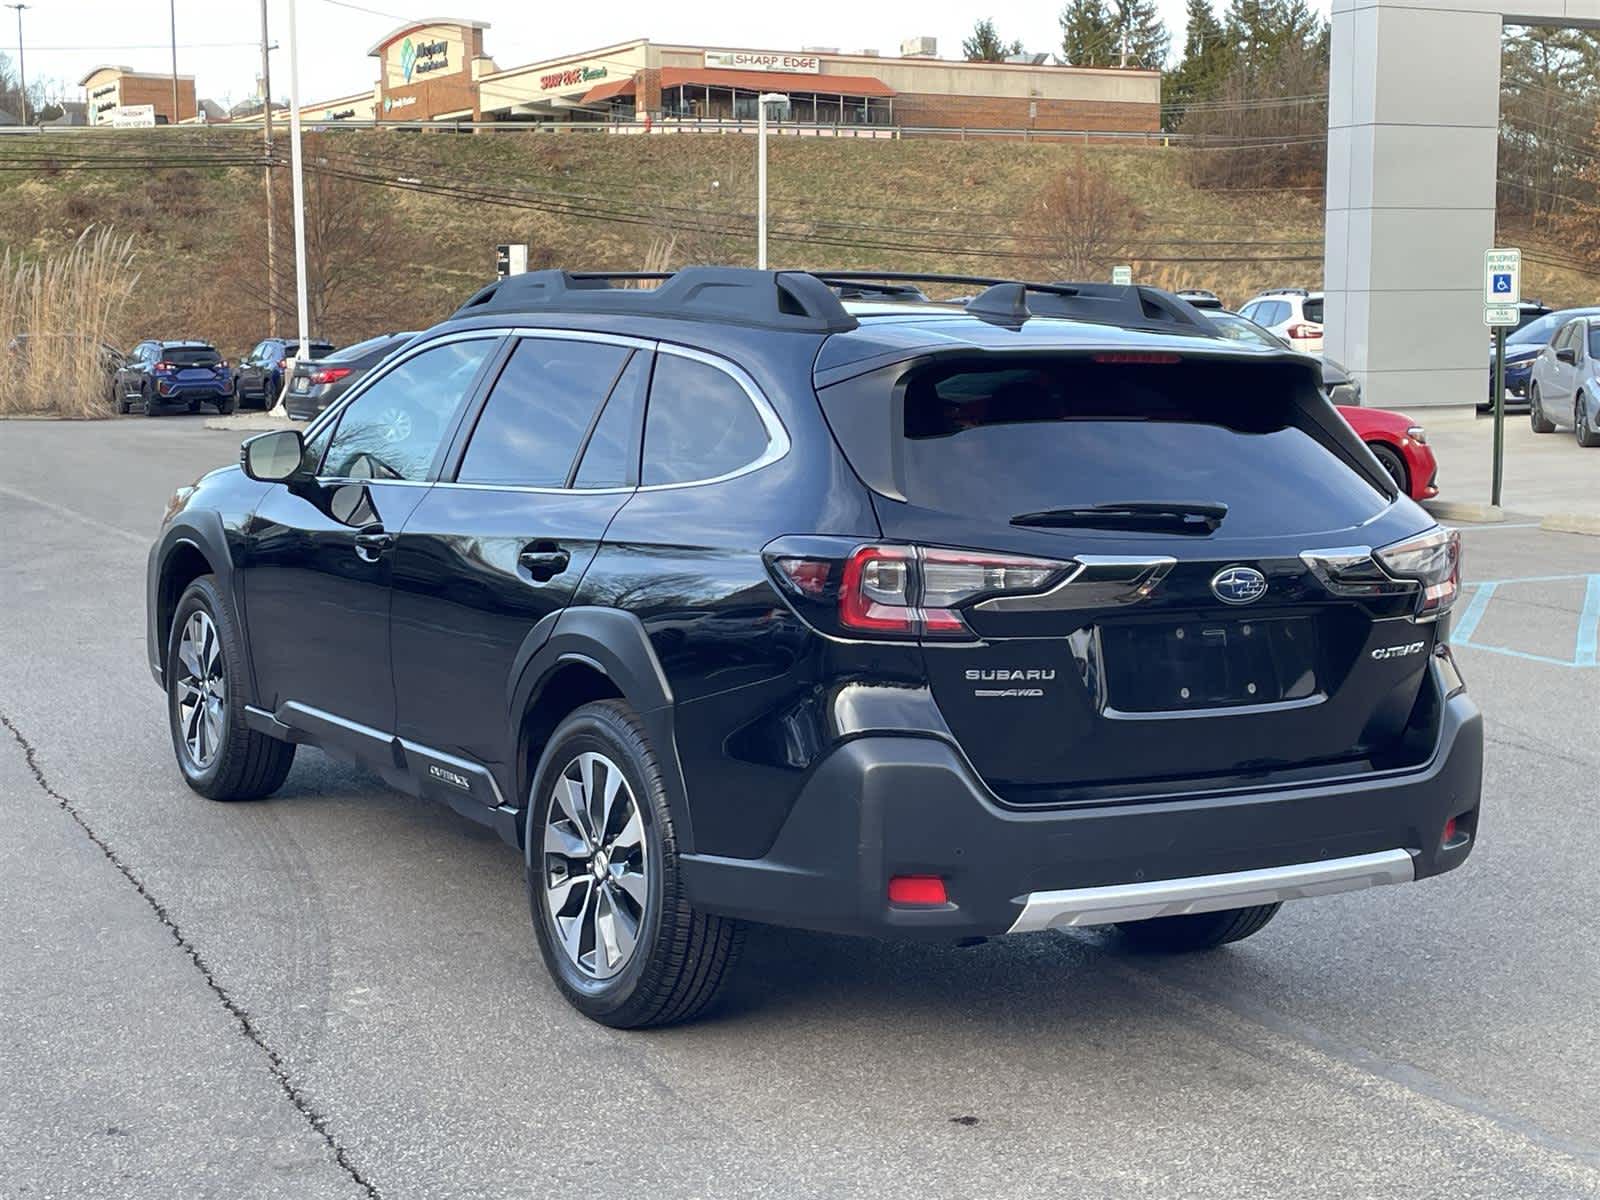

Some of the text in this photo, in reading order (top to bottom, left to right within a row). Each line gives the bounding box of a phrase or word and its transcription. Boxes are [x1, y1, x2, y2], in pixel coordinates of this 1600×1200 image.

[735, 55, 817, 68] SHARP EDGE
[1371, 641, 1425, 660] OUTBACK
[965, 670, 1056, 681] SUBARU
[1000, 688, 1044, 697] AWD
